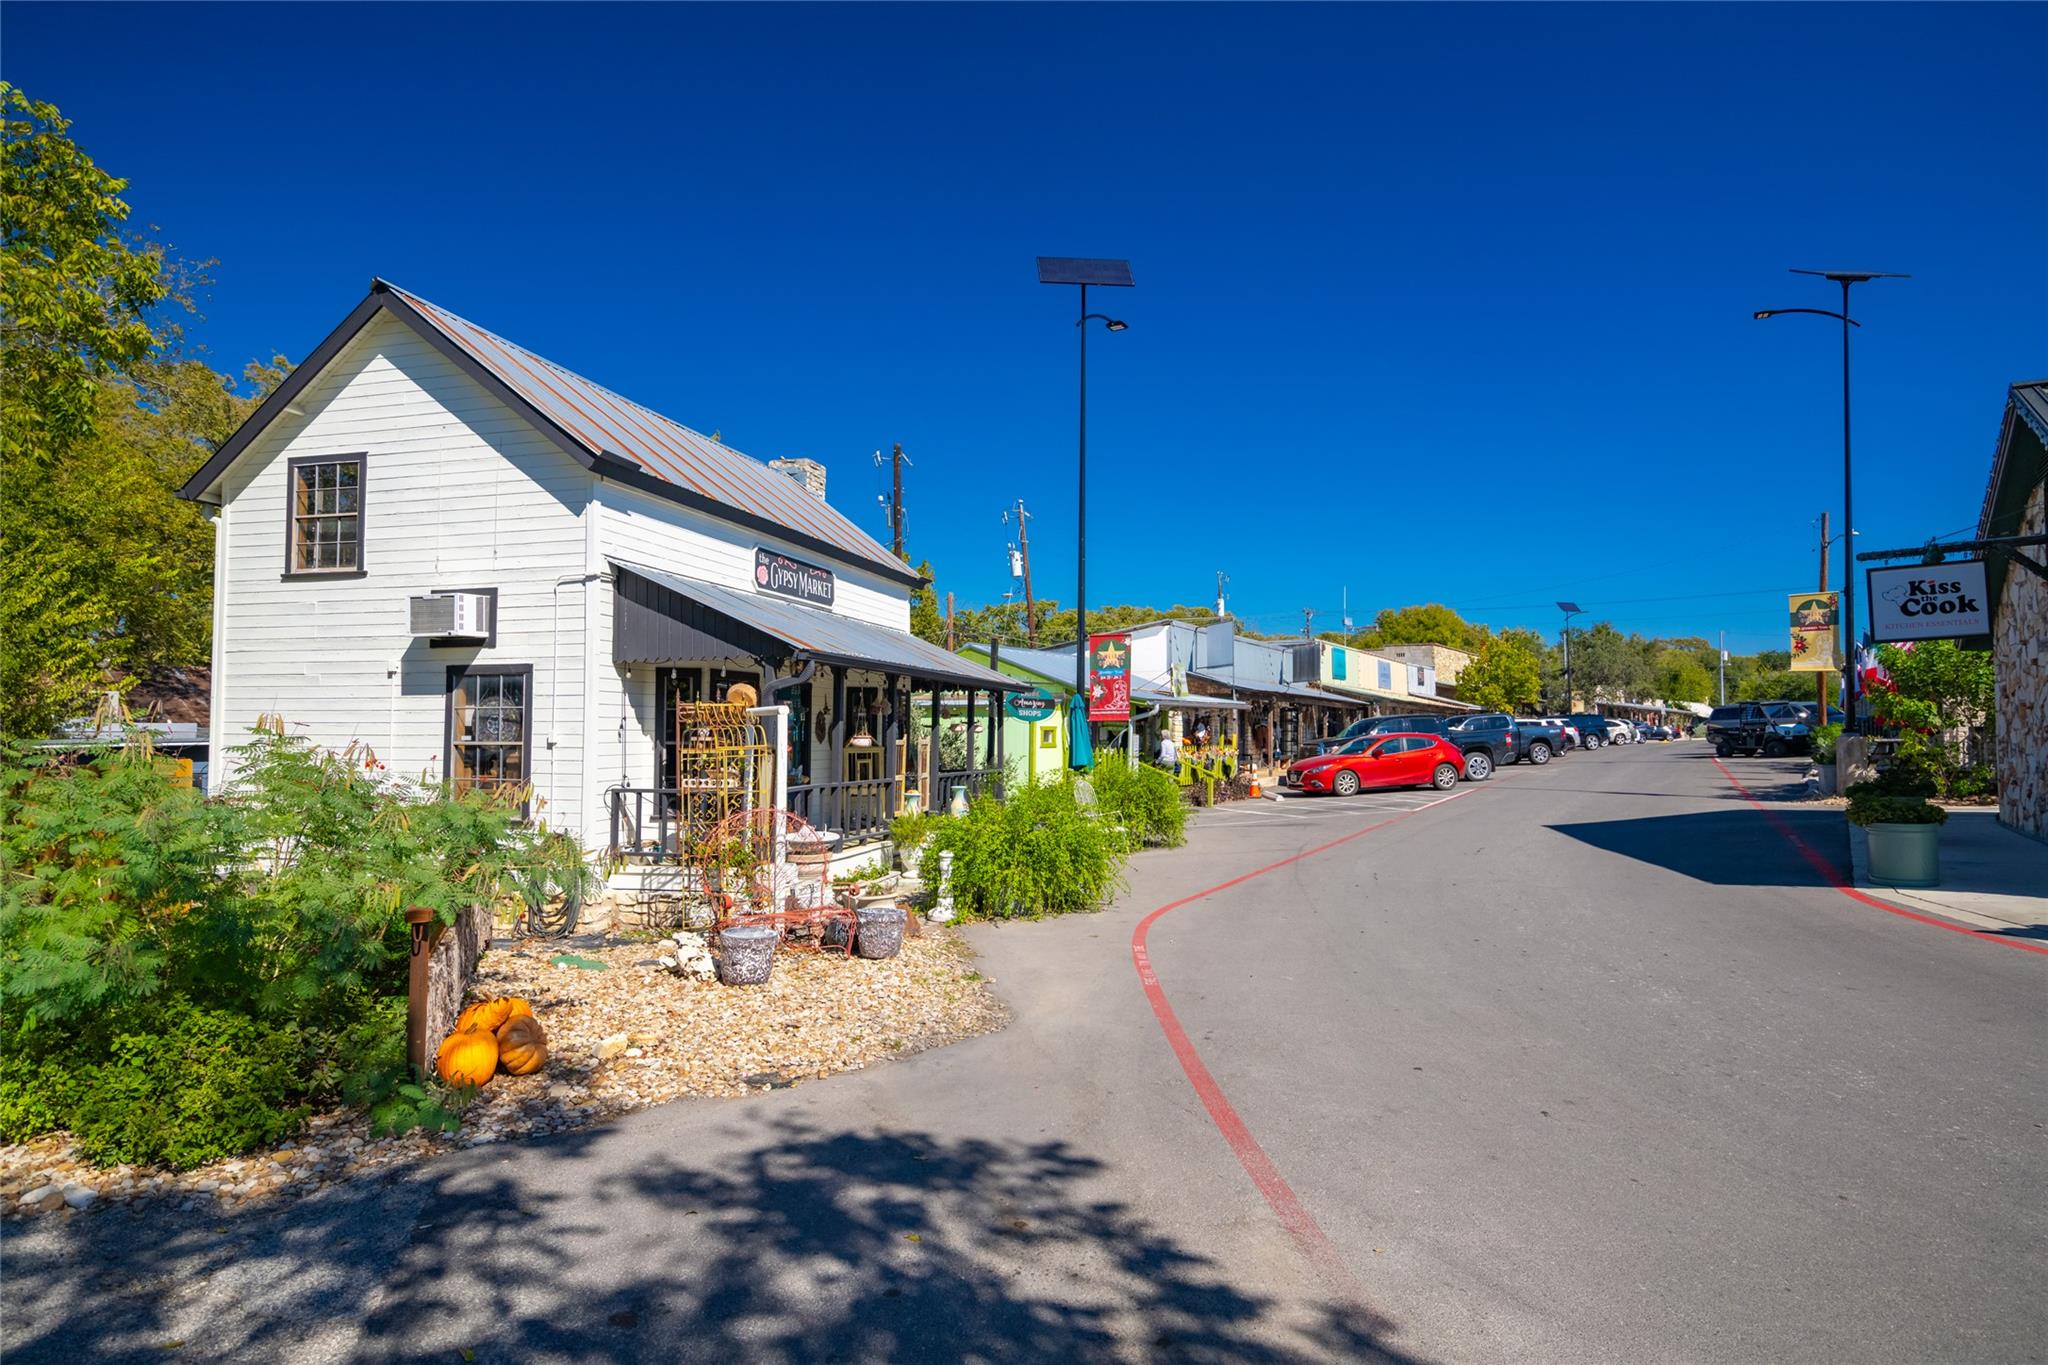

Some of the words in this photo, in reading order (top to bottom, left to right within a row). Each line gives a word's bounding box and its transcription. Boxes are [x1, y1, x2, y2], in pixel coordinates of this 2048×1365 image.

[770, 562, 798, 589] GYPSY
[799, 571, 832, 598] MARKET
[1908, 579, 1961, 596] Kiss
[1900, 594, 1979, 616] Cook
[1884, 622, 1923, 630] KITCHEN
[1926, 618, 1980, 628] ESSENTIALS
[1018, 709, 1042, 717] SHOPS
